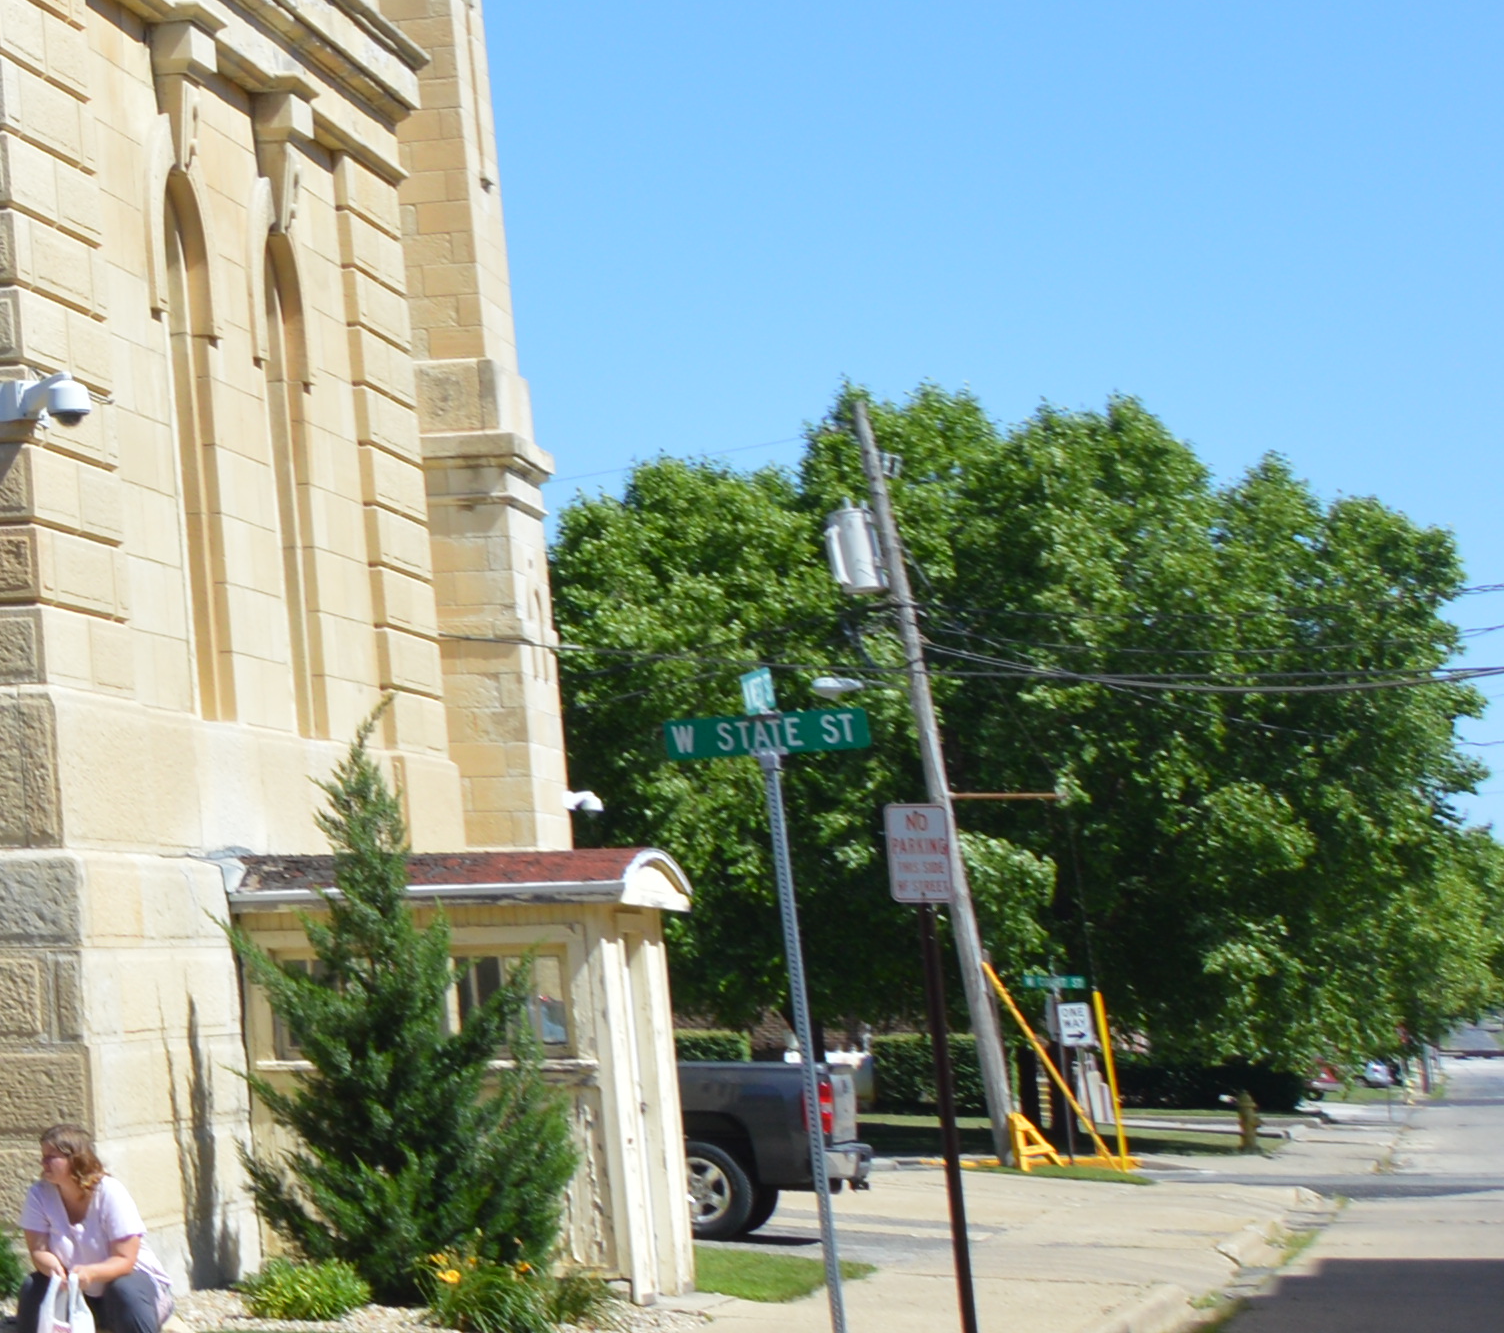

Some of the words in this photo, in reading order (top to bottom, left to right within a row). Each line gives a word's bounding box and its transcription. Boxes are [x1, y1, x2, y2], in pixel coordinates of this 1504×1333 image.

[671, 725, 695, 754] W
[716, 717, 804, 751] STATE
[820, 713, 854, 744] ST
[905, 813, 928, 832] NO
[891, 837, 950, 856] PARKING
[897, 861, 919, 874] THIS
[923, 861, 945, 874] SIDE
[912, 880, 951, 893] STREET
[1062, 1007, 1085, 1018] ONE
[1064, 1019, 1086, 1028] WAY
